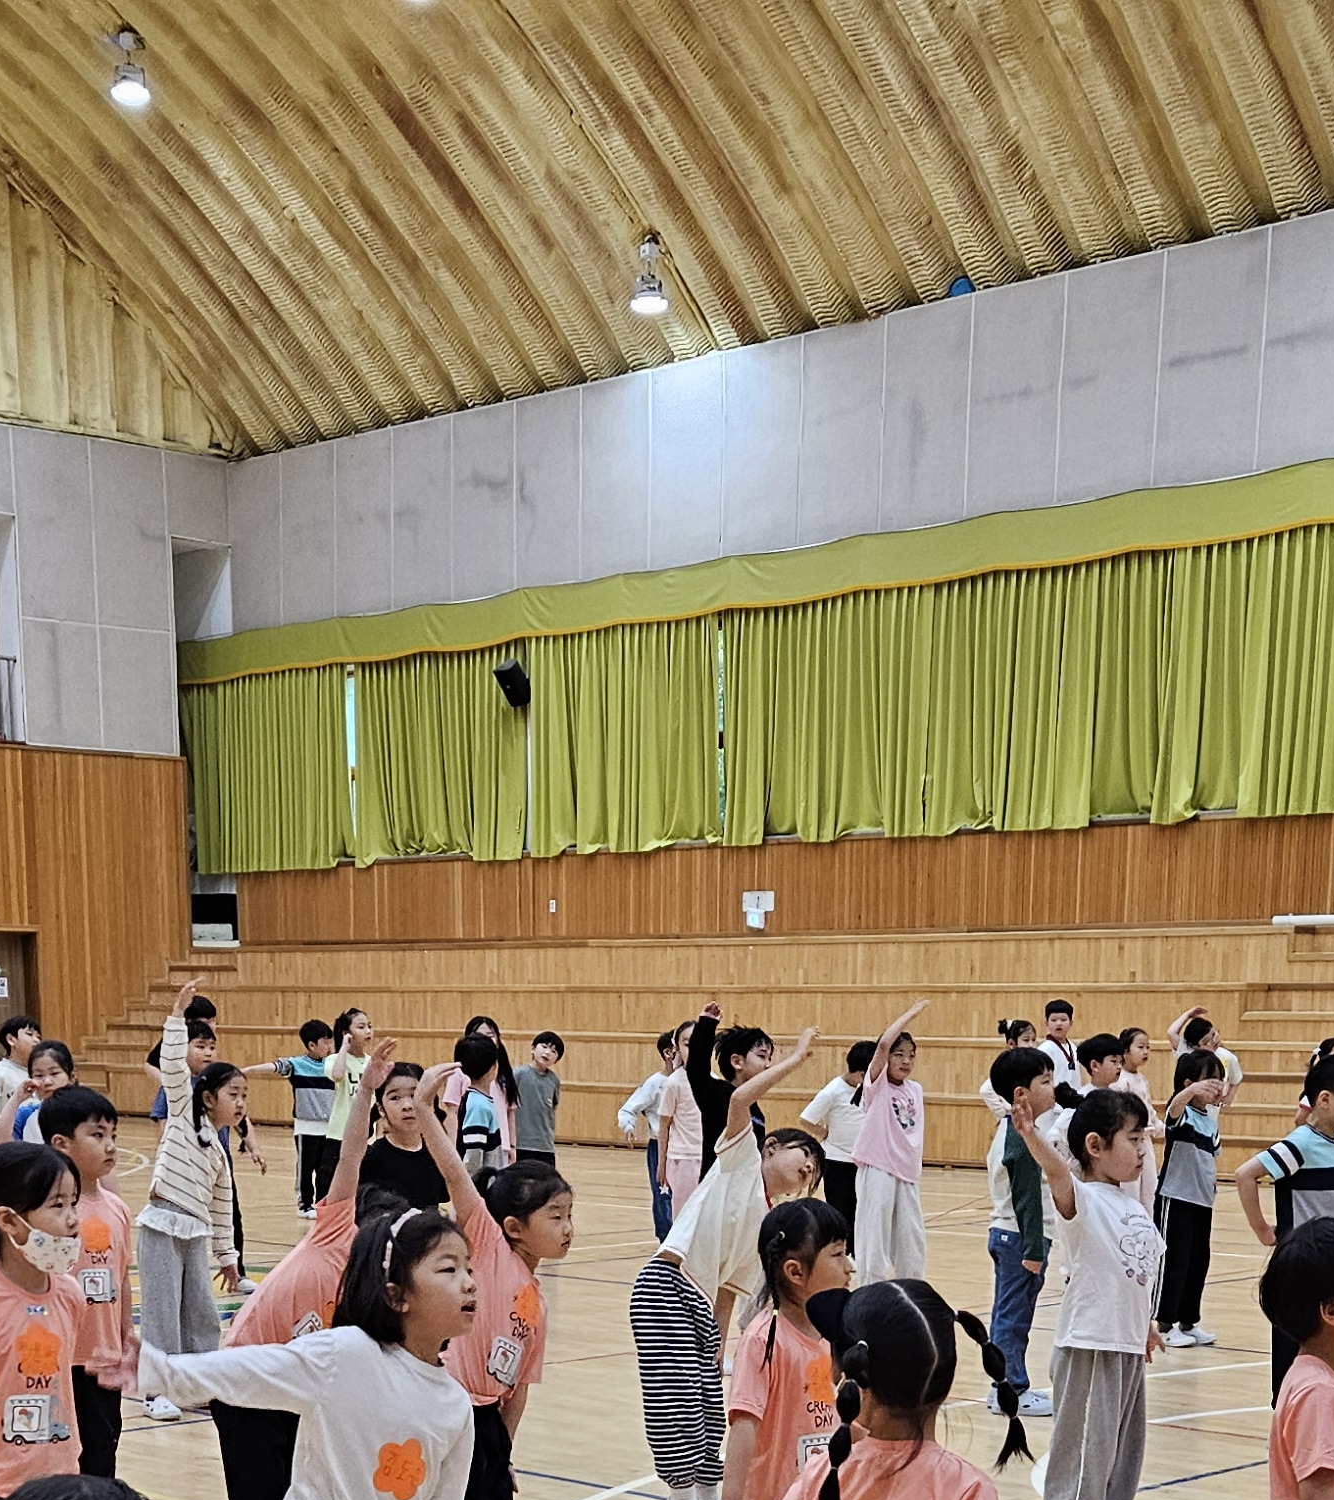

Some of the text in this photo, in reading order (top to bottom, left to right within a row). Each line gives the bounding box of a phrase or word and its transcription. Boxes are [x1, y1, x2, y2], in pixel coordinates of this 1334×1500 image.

[91, 1255, 108, 1265] DAY
[26, 1376, 52, 1389] DAY
[814, 1414, 834, 1428] DAY
